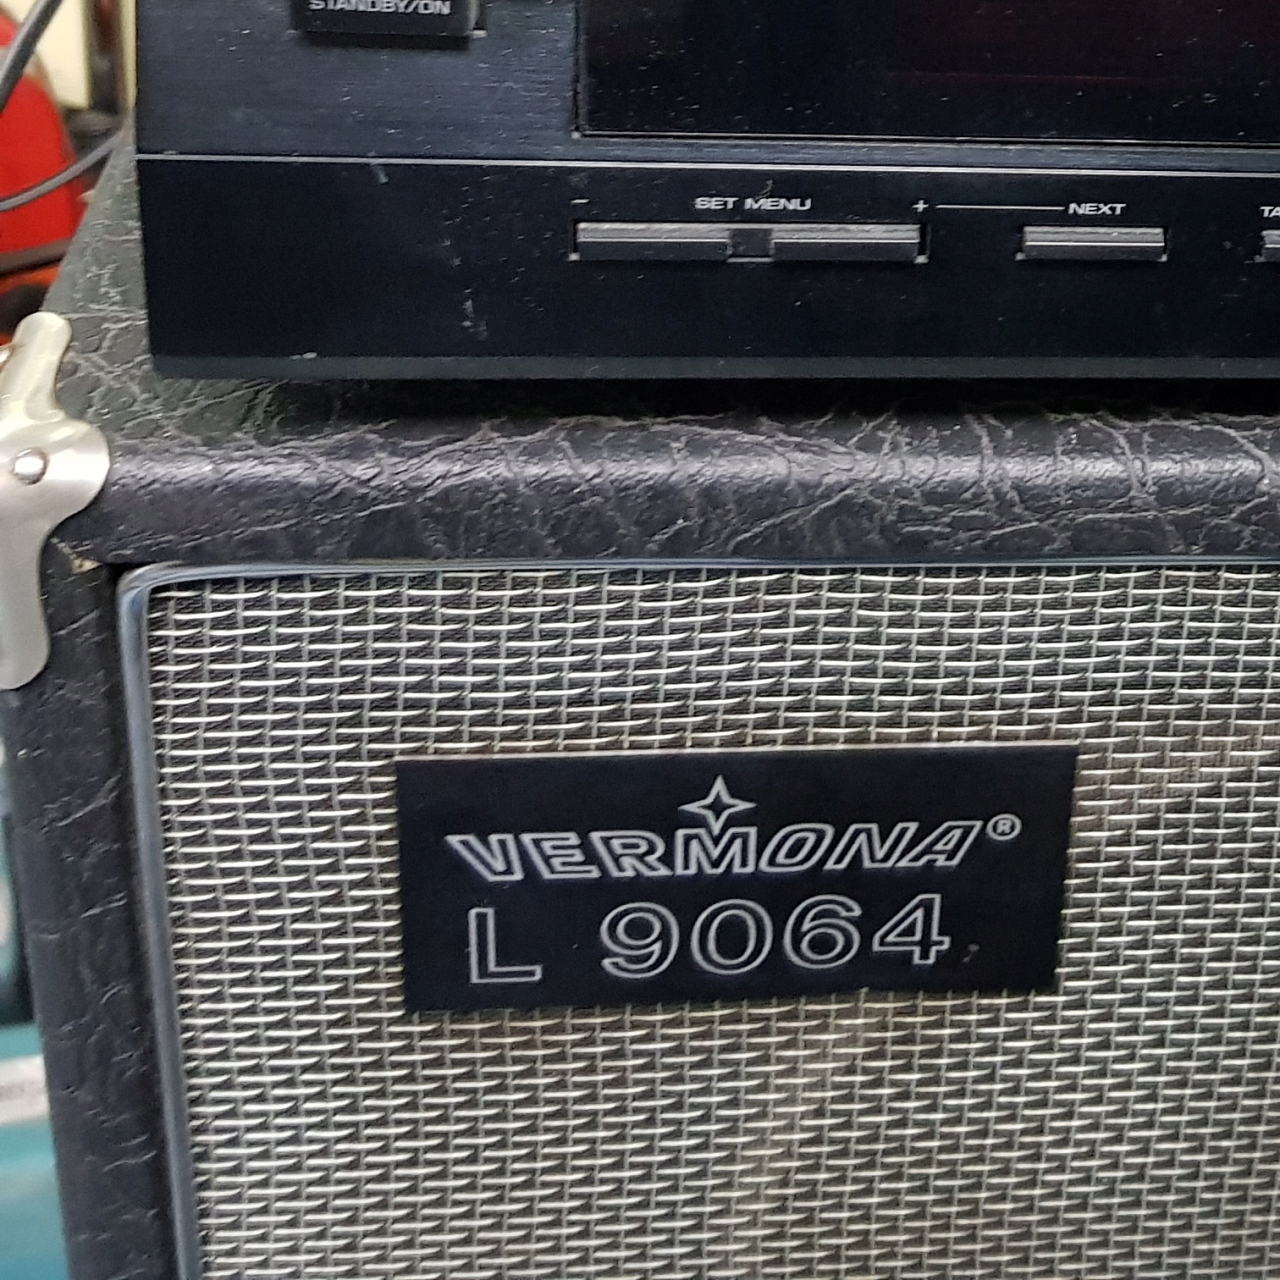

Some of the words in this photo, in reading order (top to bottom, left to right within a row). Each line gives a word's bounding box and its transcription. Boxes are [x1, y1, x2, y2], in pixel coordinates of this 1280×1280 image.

[694, 196, 739, 212] SET
[743, 197, 813, 213] MENU
[1068, 201, 1127, 217] NEXT
[444, 818, 984, 882] VERMONA
[468, 905, 543, 985] L
[600, 892, 952, 979] 9064
